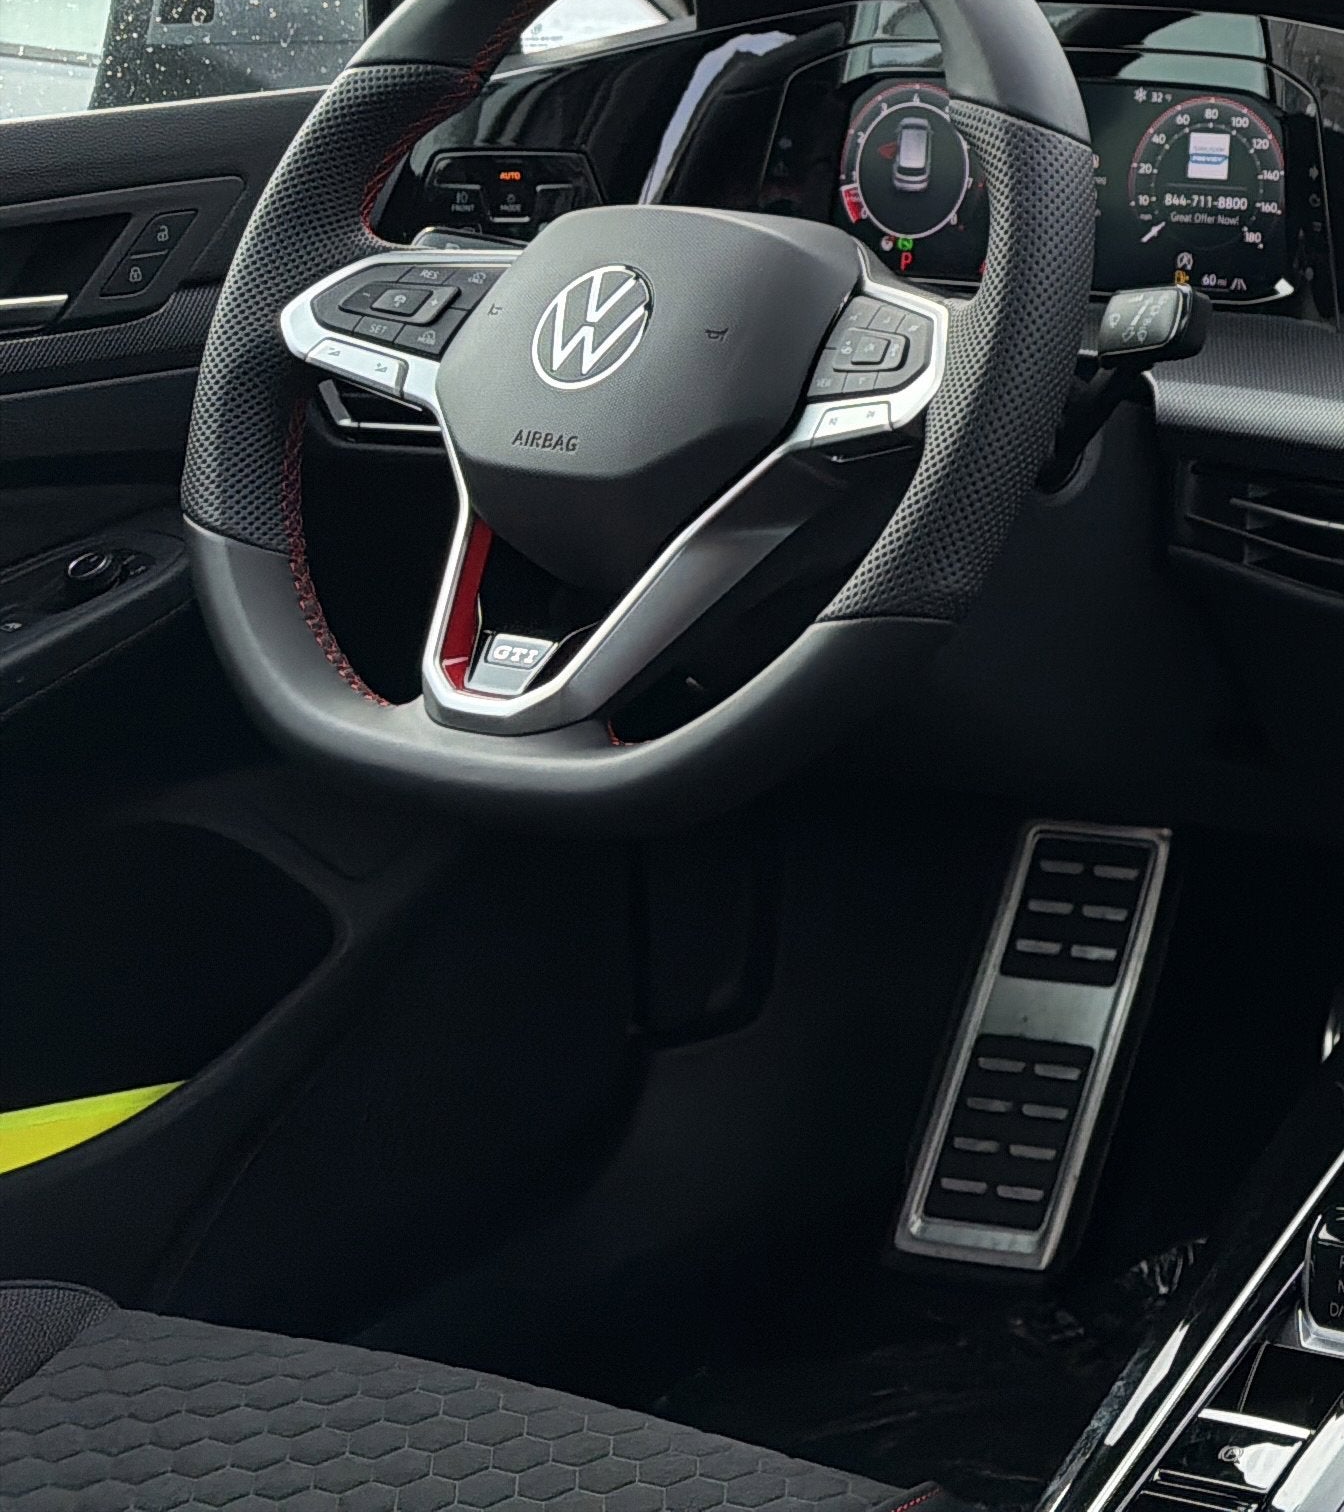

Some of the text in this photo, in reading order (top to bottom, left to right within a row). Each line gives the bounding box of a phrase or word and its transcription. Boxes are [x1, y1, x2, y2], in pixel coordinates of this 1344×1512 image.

[1151, 92, 1163, 103] 32
[1175, 114, 1191, 126] 60
[1204, 108, 1219, 120] 80
[1231, 116, 1250, 128] 100
[1151, 133, 1167, 145] 40
[1252, 138, 1270, 150] 120
[1138, 163, 1153, 175] 20
[1262, 169, 1280, 181] 140
[499, 171, 522, 181] AUTO
[1138, 194, 1150, 206] 10
[1164, 192, 1249, 211] 844-711-8800
[1260, 201, 1278, 214] 160
[1170, 210, 1240, 226] Great Offer Now!
[1243, 231, 1262, 244] 180
[901, 251, 913, 272] P
[420, 269, 440, 281] RES
[1201, 274, 1217, 286] 60
[369, 324, 388, 335] SET
[511, 428, 580, 454] AIRBAG
[492, 643, 539, 666] GTI
